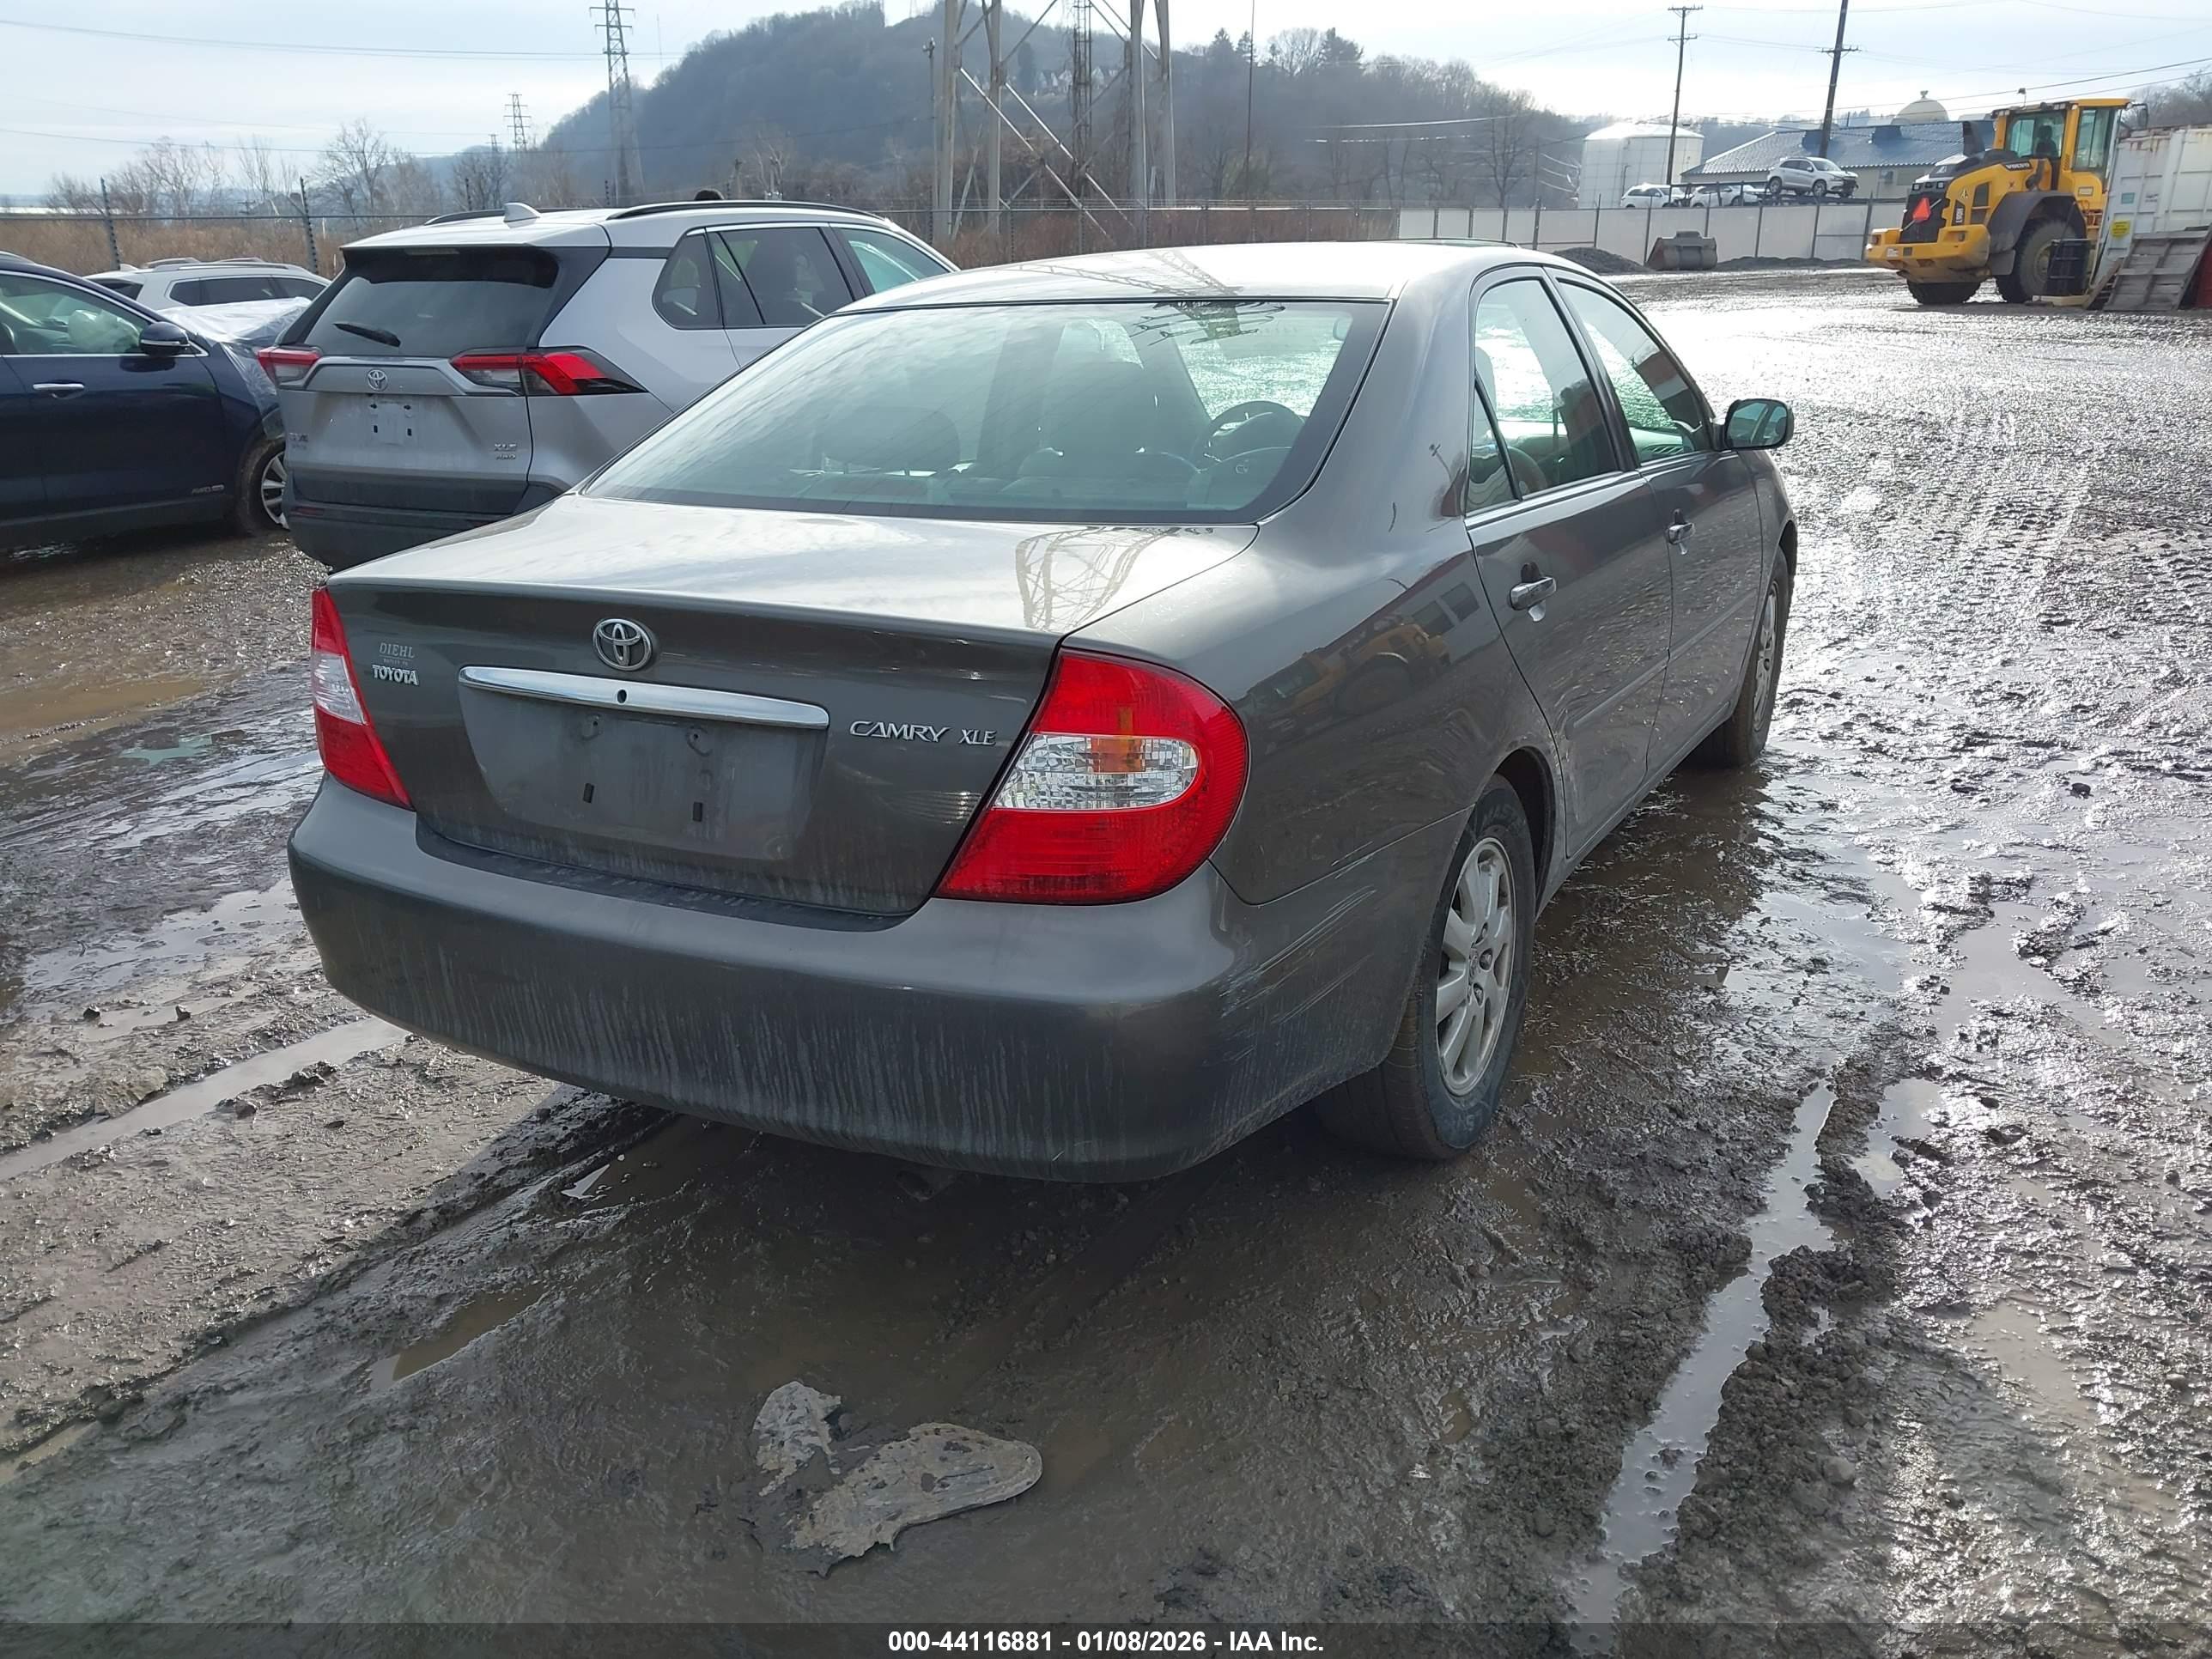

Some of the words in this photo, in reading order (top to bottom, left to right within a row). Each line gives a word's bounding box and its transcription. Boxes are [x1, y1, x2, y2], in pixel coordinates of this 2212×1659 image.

[2005, 161, 2030, 170] VOLVO
[379, 642, 415, 659] DIEHL
[372, 664, 419, 686] TOYOTA
[850, 720, 951, 743] CAMRY
[958, 729, 997, 745] XLE
